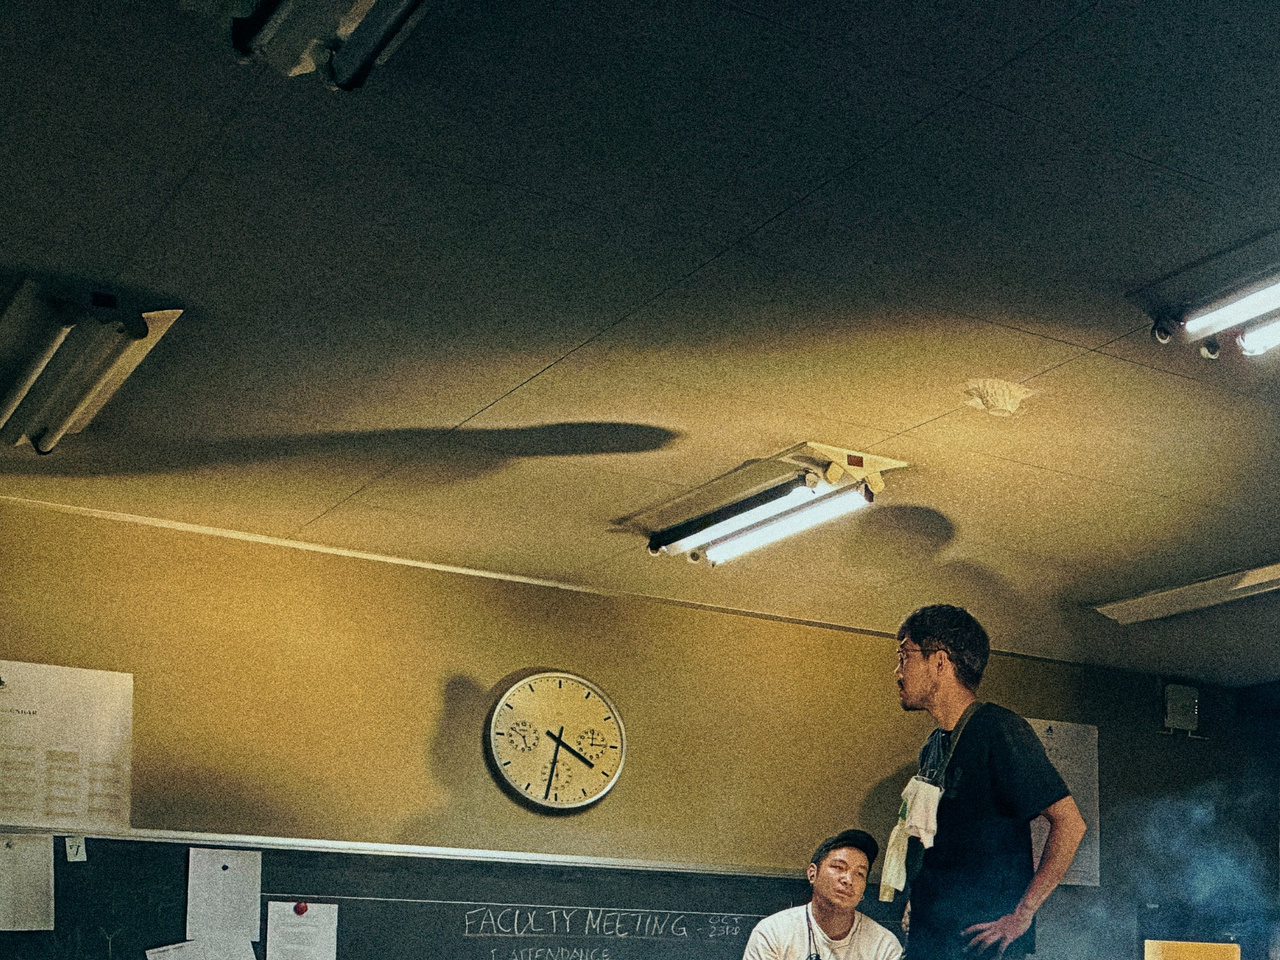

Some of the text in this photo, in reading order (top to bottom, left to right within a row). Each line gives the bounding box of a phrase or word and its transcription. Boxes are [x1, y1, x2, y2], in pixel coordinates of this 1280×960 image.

[464, 908, 577, 935] FACULTY
[585, 908, 688, 937] MEETING
[708, 915, 742, 925] OCT
